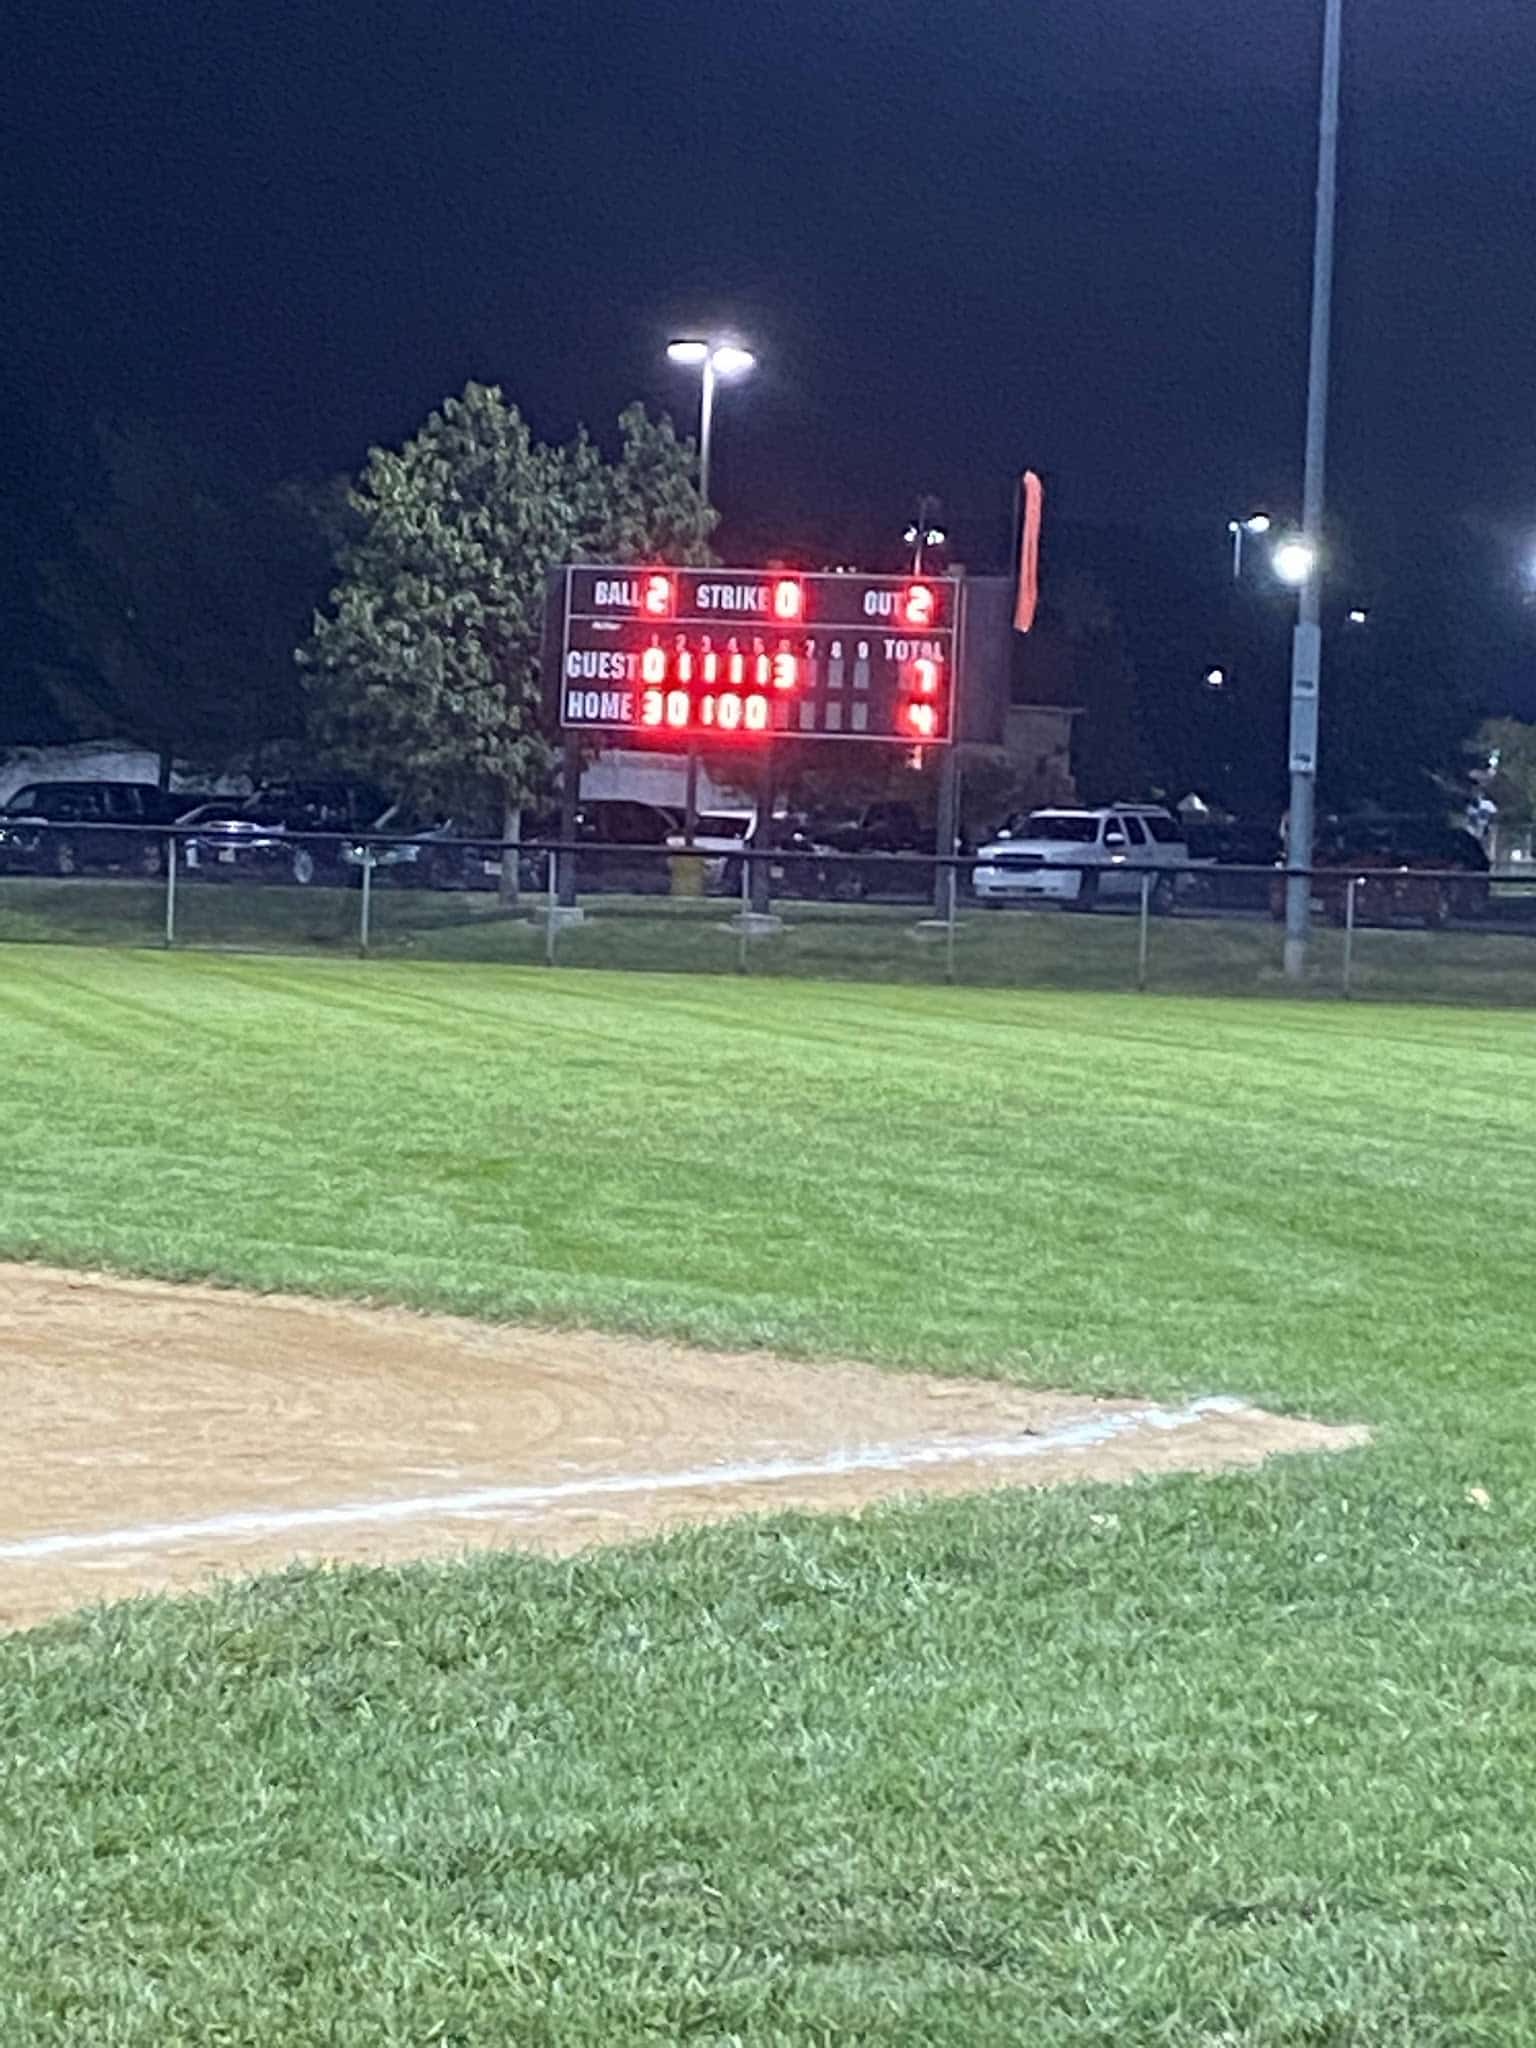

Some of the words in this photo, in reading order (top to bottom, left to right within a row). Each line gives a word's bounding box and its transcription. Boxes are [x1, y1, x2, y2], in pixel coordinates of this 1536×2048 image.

[595, 581, 641, 607] BALL
[646, 575, 670, 614] 2
[696, 584, 770, 611] STRIKE
[775, 581, 799, 617] 0
[864, 590, 904, 617] OUT
[906, 585, 933, 623] 2
[676, 634, 686, 651] 2
[702, 635, 711, 653] 3
[728, 637, 738, 653] 4
[806, 639, 815, 658] 7
[831, 641, 841, 659] 8
[858, 641, 868, 659] 9
[883, 639, 944, 662] TOTAL
[567, 651, 638, 680] GUEST
[643, 647, 665, 684] 0
[679, 652, 691, 682] 1
[704, 653, 716, 684] 1
[731, 653, 743, 684] 1
[757, 653, 769, 685] 1
[774, 653, 796, 688] 3
[568, 690, 634, 720] HOME
[643, 690, 663, 726] 3
[667, 691, 689, 727] 0
[718, 693, 741, 729] 0
[745, 694, 768, 730] 0
[909, 703, 934, 735] 4
